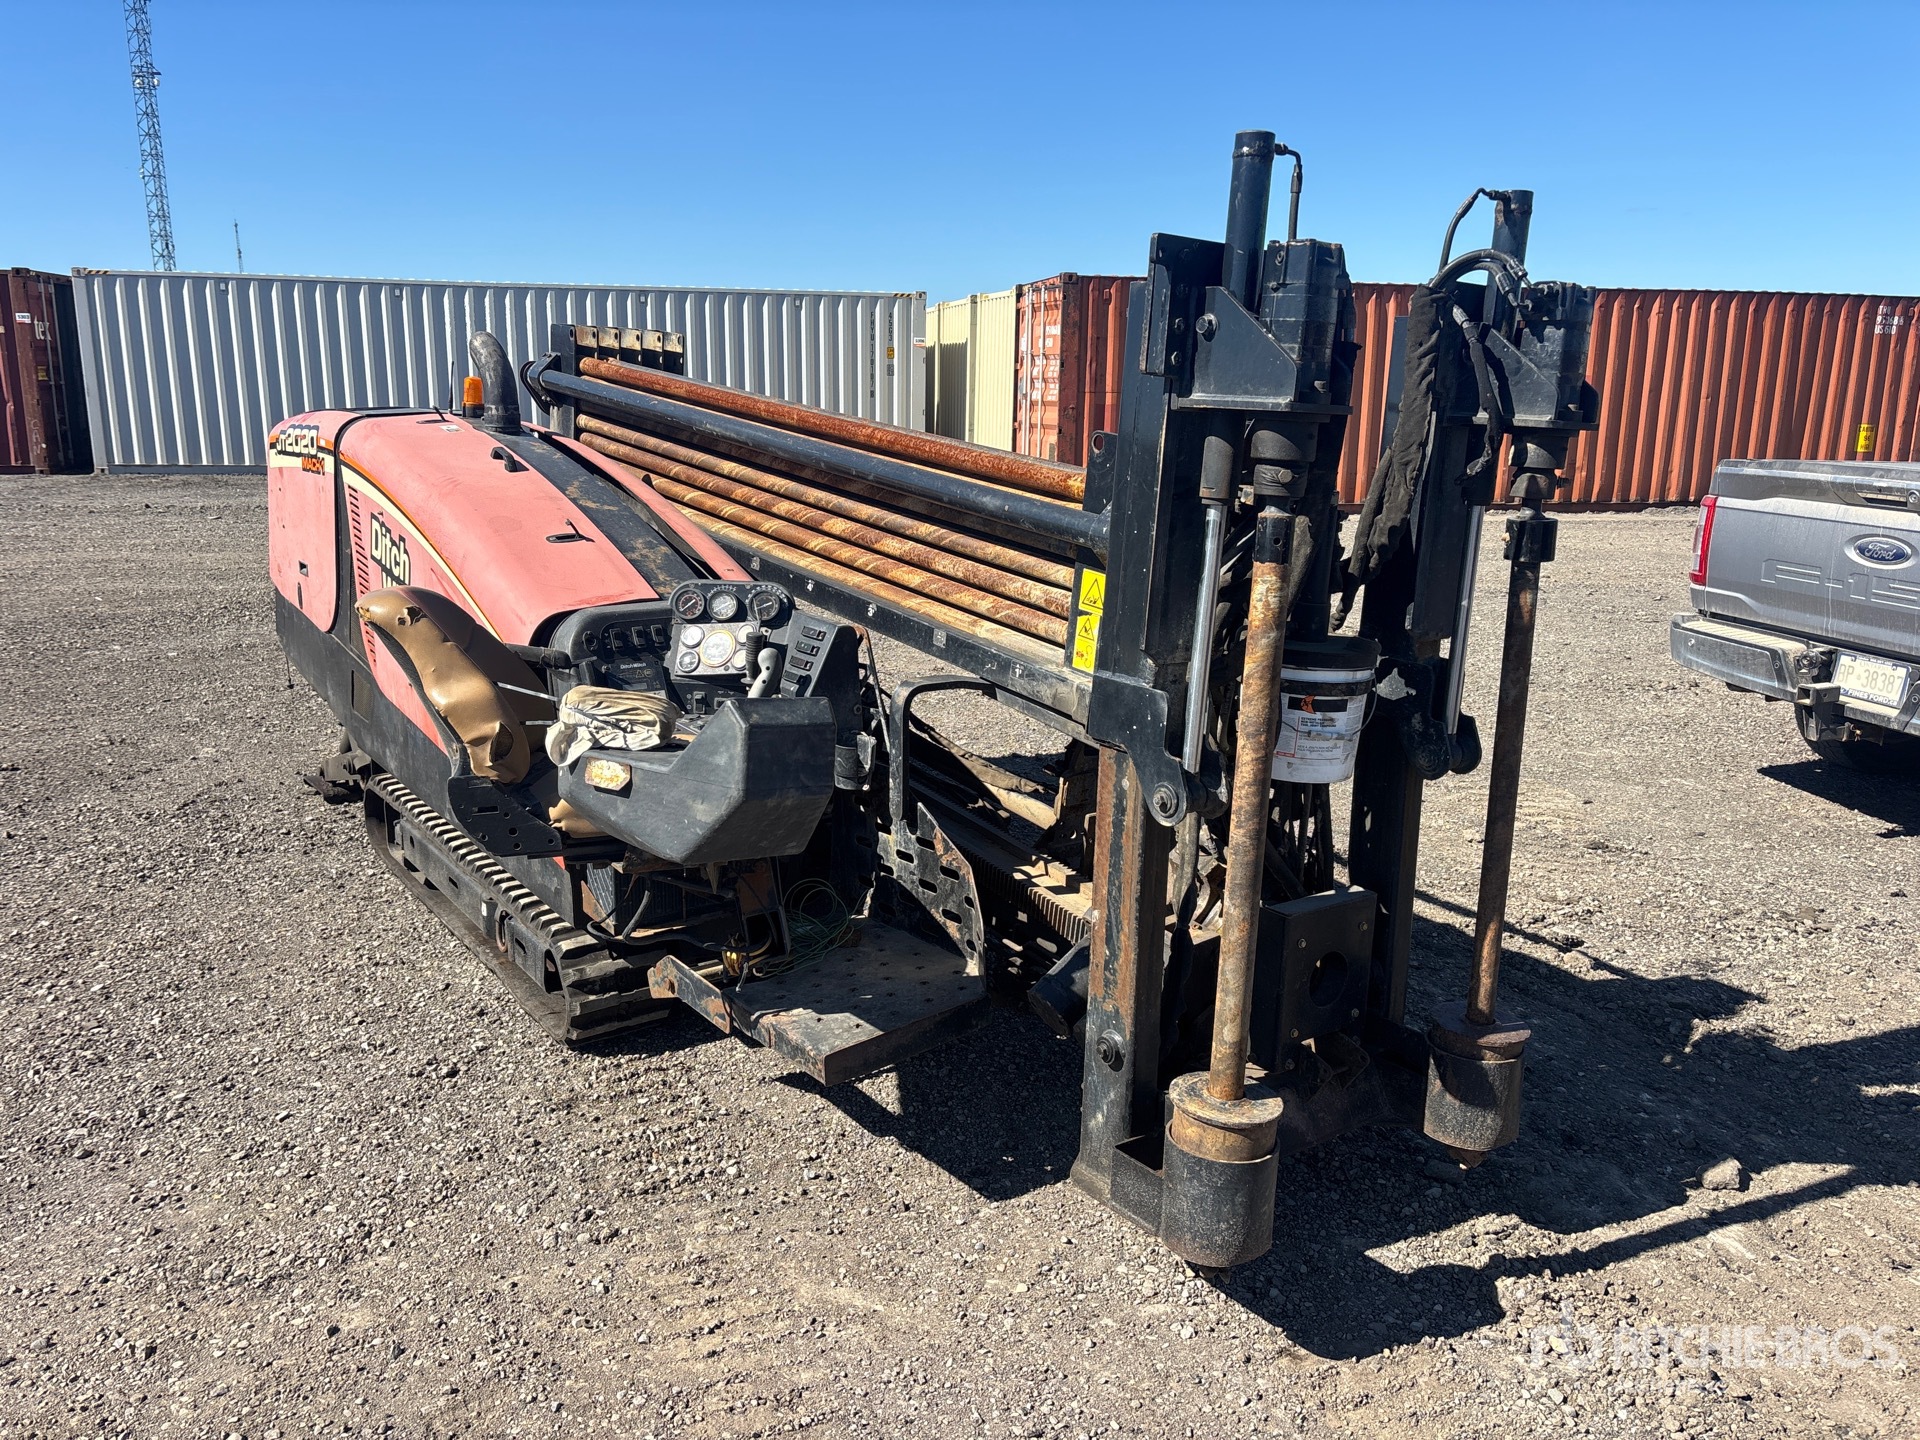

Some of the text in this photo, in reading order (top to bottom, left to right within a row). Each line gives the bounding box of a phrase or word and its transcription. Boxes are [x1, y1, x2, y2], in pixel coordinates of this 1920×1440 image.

[276, 425, 319, 456] JT2020
[371, 517, 410, 586] Ditch
[1864, 541, 1897, 561] Ford
[1861, 668, 1904, 697] 38387
